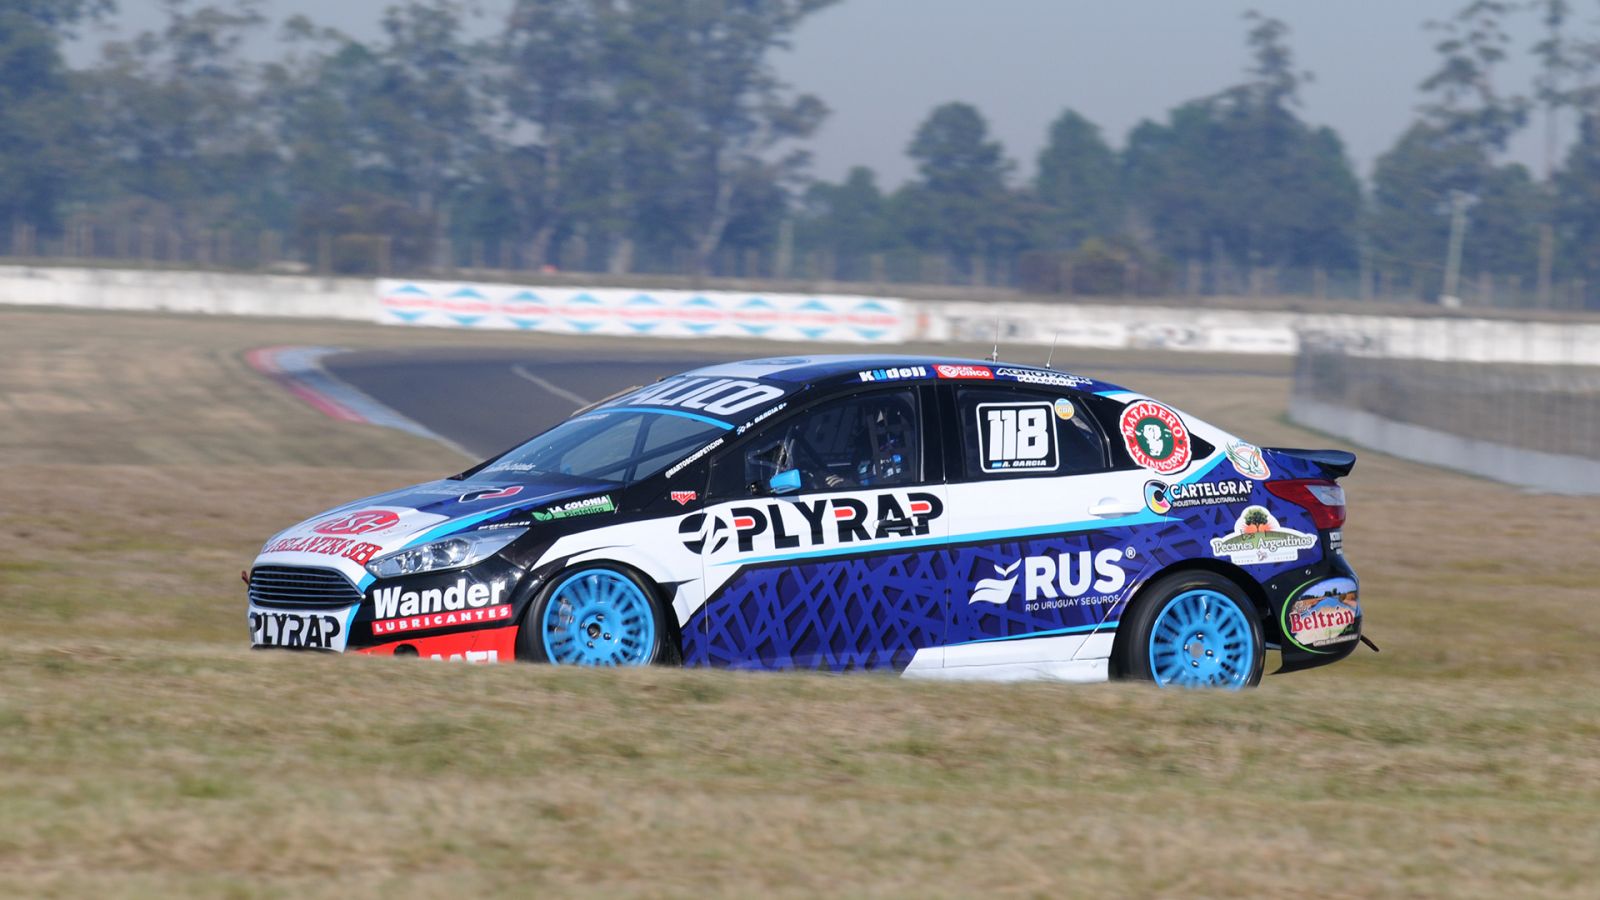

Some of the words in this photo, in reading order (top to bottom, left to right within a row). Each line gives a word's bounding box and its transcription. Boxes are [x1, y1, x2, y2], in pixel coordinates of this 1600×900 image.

[859, 366, 926, 382] Kudell
[1017, 375, 1077, 387] PATAGONIA
[1123, 404, 1184, 438] MATADERO
[987, 408, 1049, 461] 118
[1002, 460, 1011, 468] A.
[1131, 445, 1187, 471] MUNICIPAL
[1170, 480, 1253, 500] CARTELGRAF
[549, 505, 563, 514] LA
[564, 496, 608, 511] COLONIA
[1172, 499, 1201, 508] INDUSTRIA
[1201, 497, 1237, 505] PUBLICITARIA
[731, 492, 944, 552] PLYRAP
[1214, 541, 1253, 554] Pecanes
[1256, 535, 1314, 551] Argentinos
[372, 579, 507, 619] Wander
[1025, 603, 1040, 612] RIO
[1041, 599, 1079, 610] URUGUAY
[1080, 594, 1120, 606] SEGUROS
[249, 611, 341, 648] PLYRAP
[375, 605, 511, 633] LUBRICANTES
[1290, 606, 1355, 633] Beltrán
